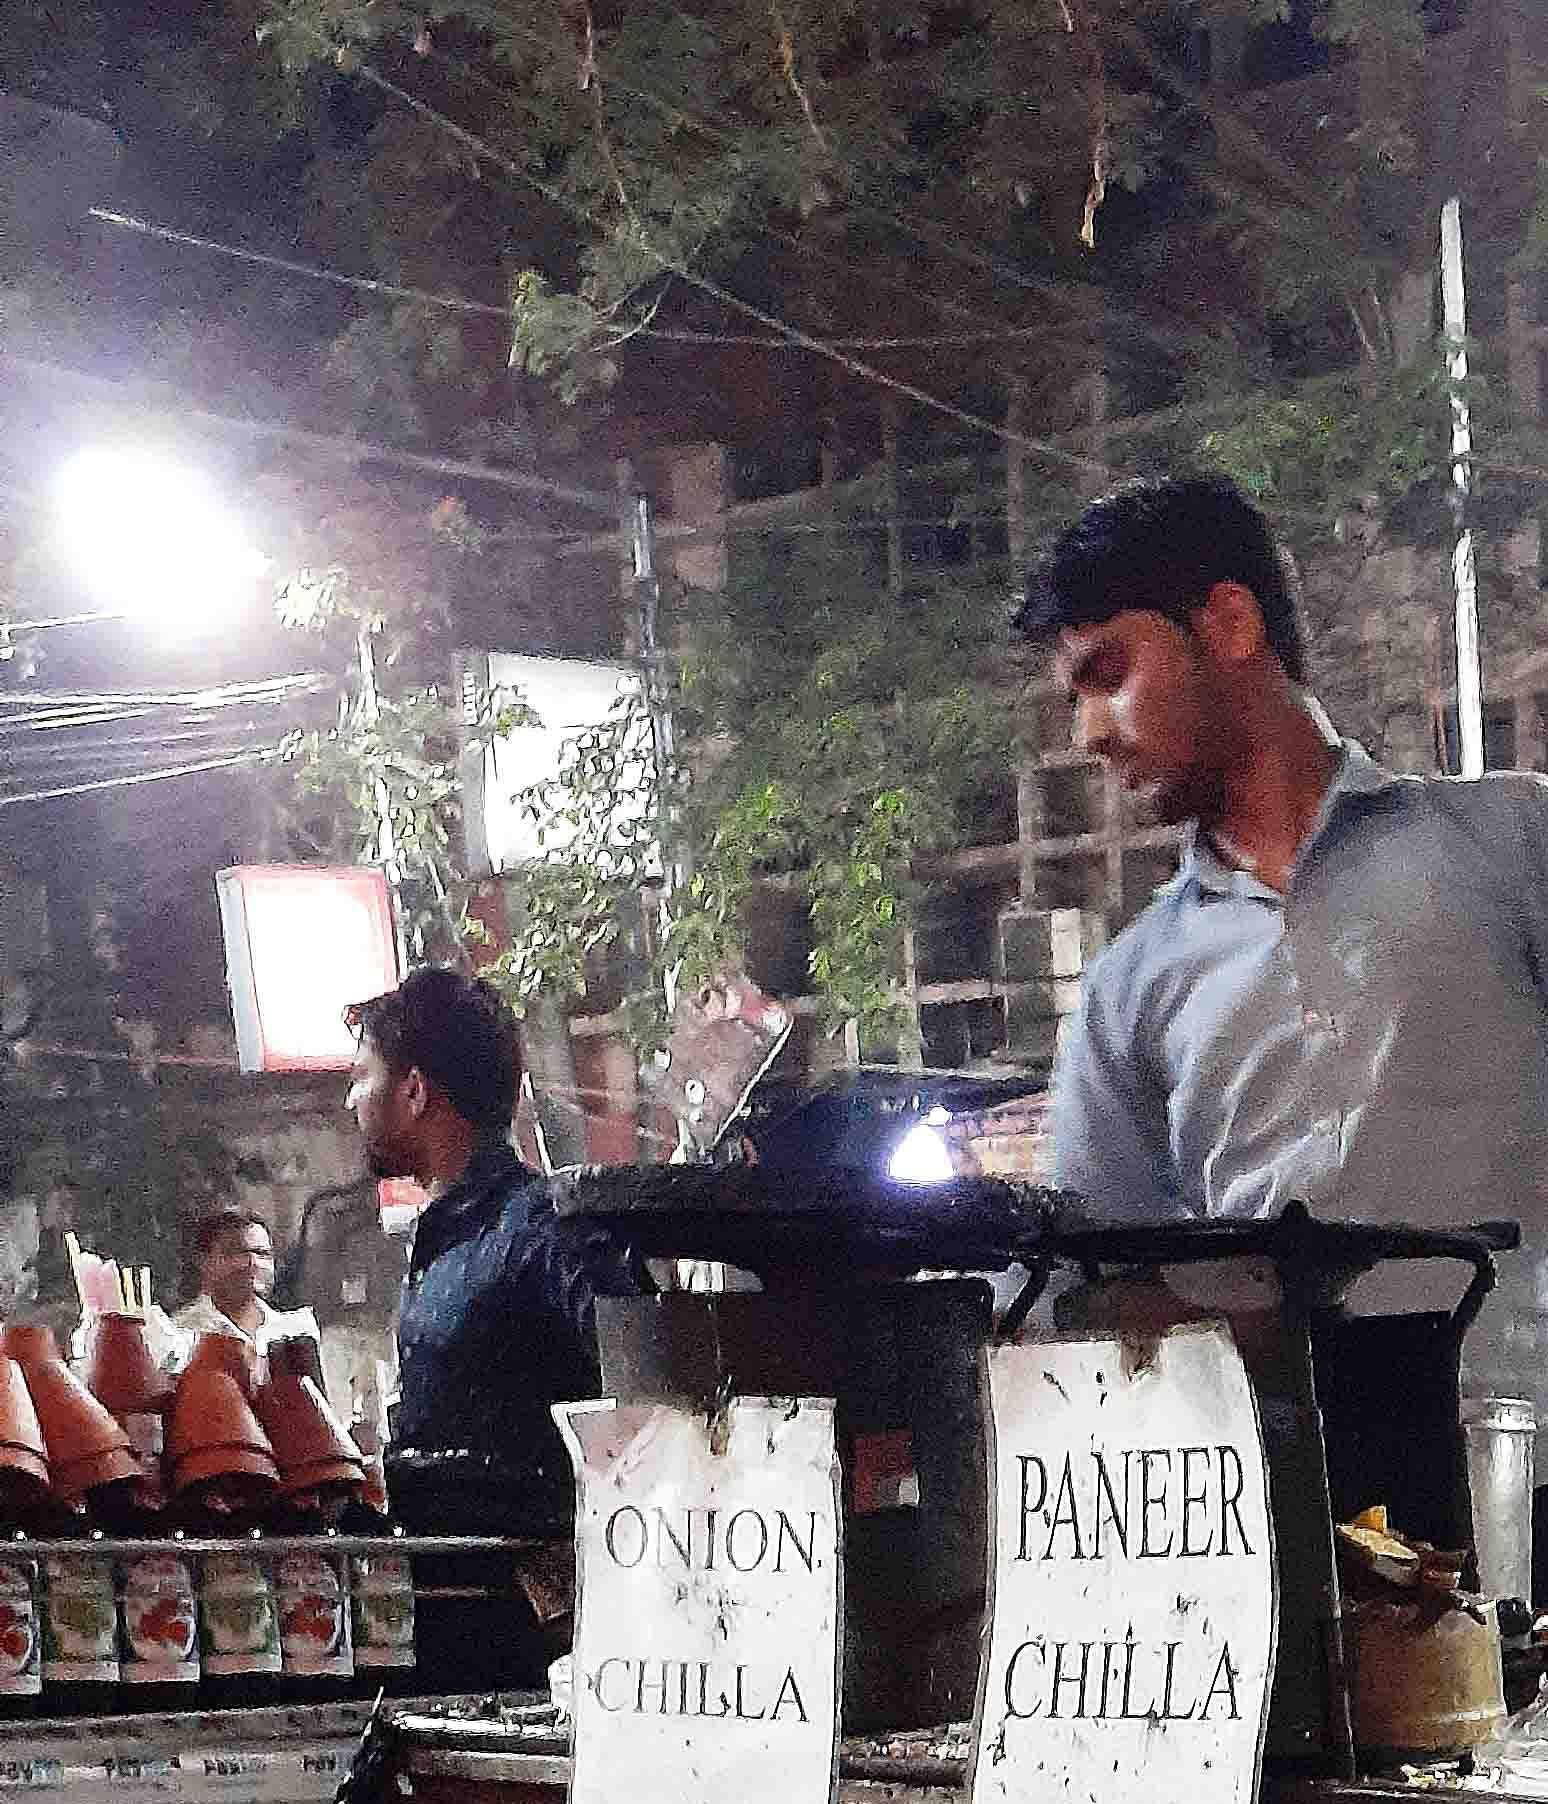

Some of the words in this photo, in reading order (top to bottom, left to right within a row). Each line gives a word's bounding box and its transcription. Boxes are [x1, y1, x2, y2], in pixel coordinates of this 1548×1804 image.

[606, 1504, 817, 1573] ONION
[1015, 1445, 1256, 1562] PANEER
[595, 1656, 810, 1723] CHILLA
[1004, 1640, 1243, 1721] CHILLA
